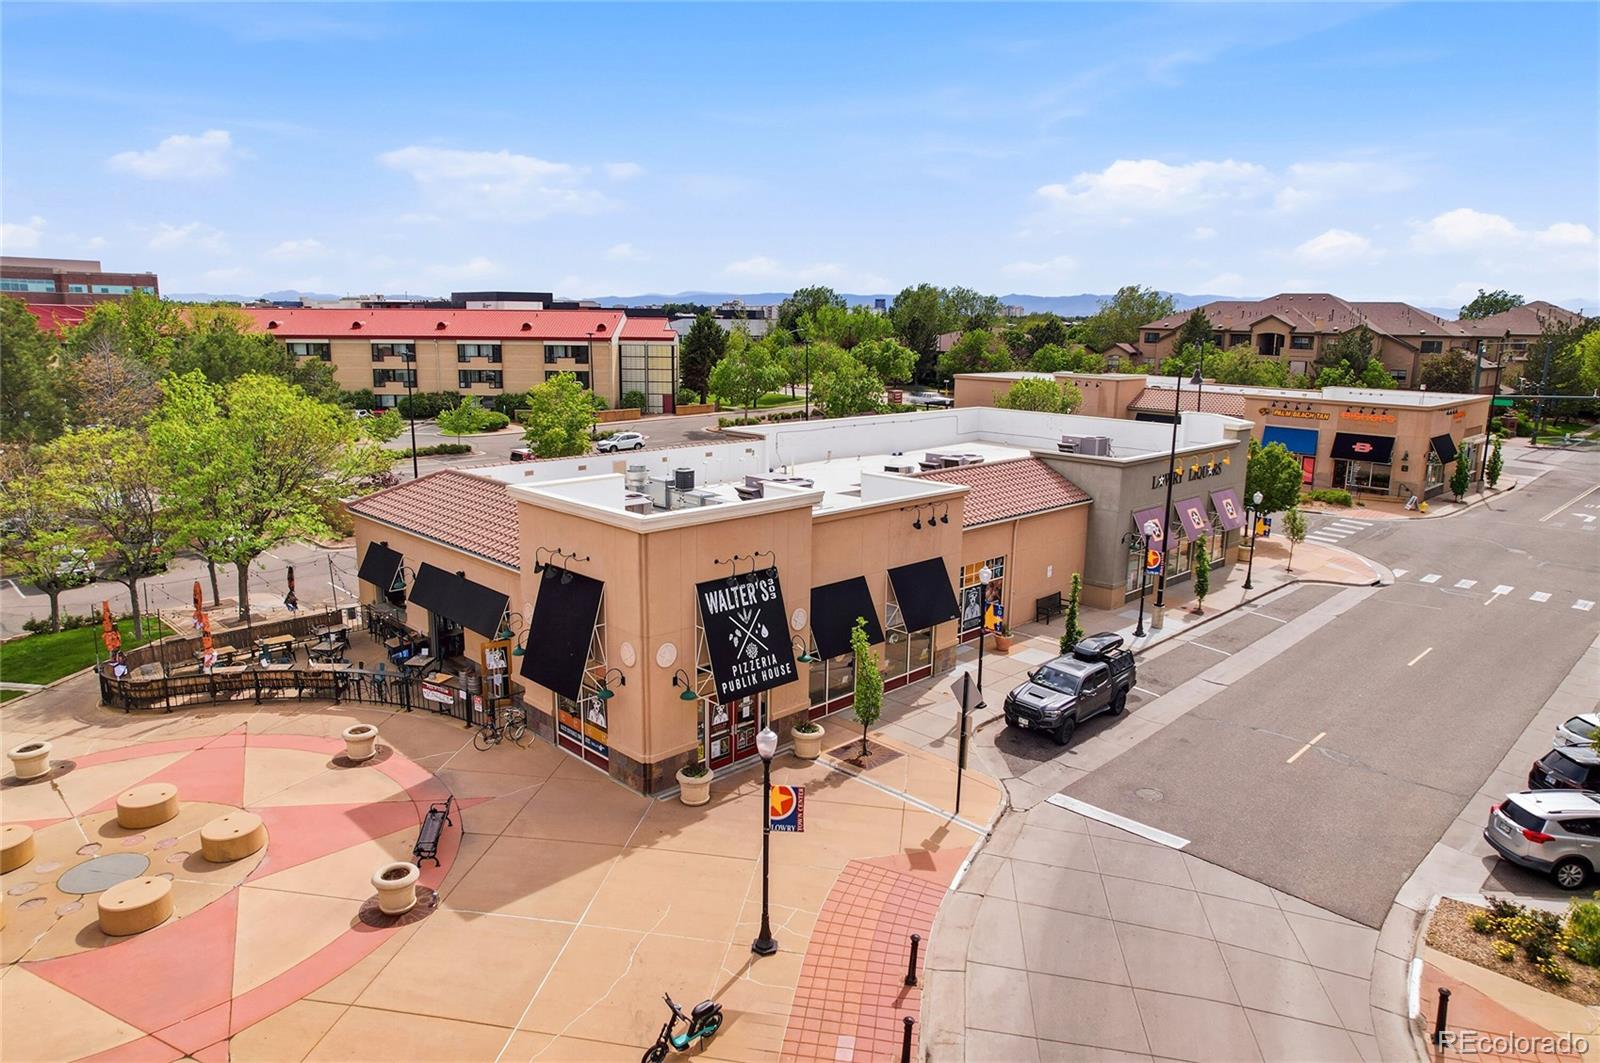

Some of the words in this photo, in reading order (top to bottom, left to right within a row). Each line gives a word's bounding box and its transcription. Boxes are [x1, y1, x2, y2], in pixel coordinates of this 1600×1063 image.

[1273, 409, 1291, 417] PALM
[1292, 411, 1315, 419] BEACH
[1316, 412, 1330, 420] TAN
[704, 579, 770, 615] WALTER'S
[732, 653, 778, 677] PIZZERIA
[721, 674, 758, 694] PUBLIK
[762, 662, 792, 682] HOUSE
[771, 824, 796, 832] LOWRY
